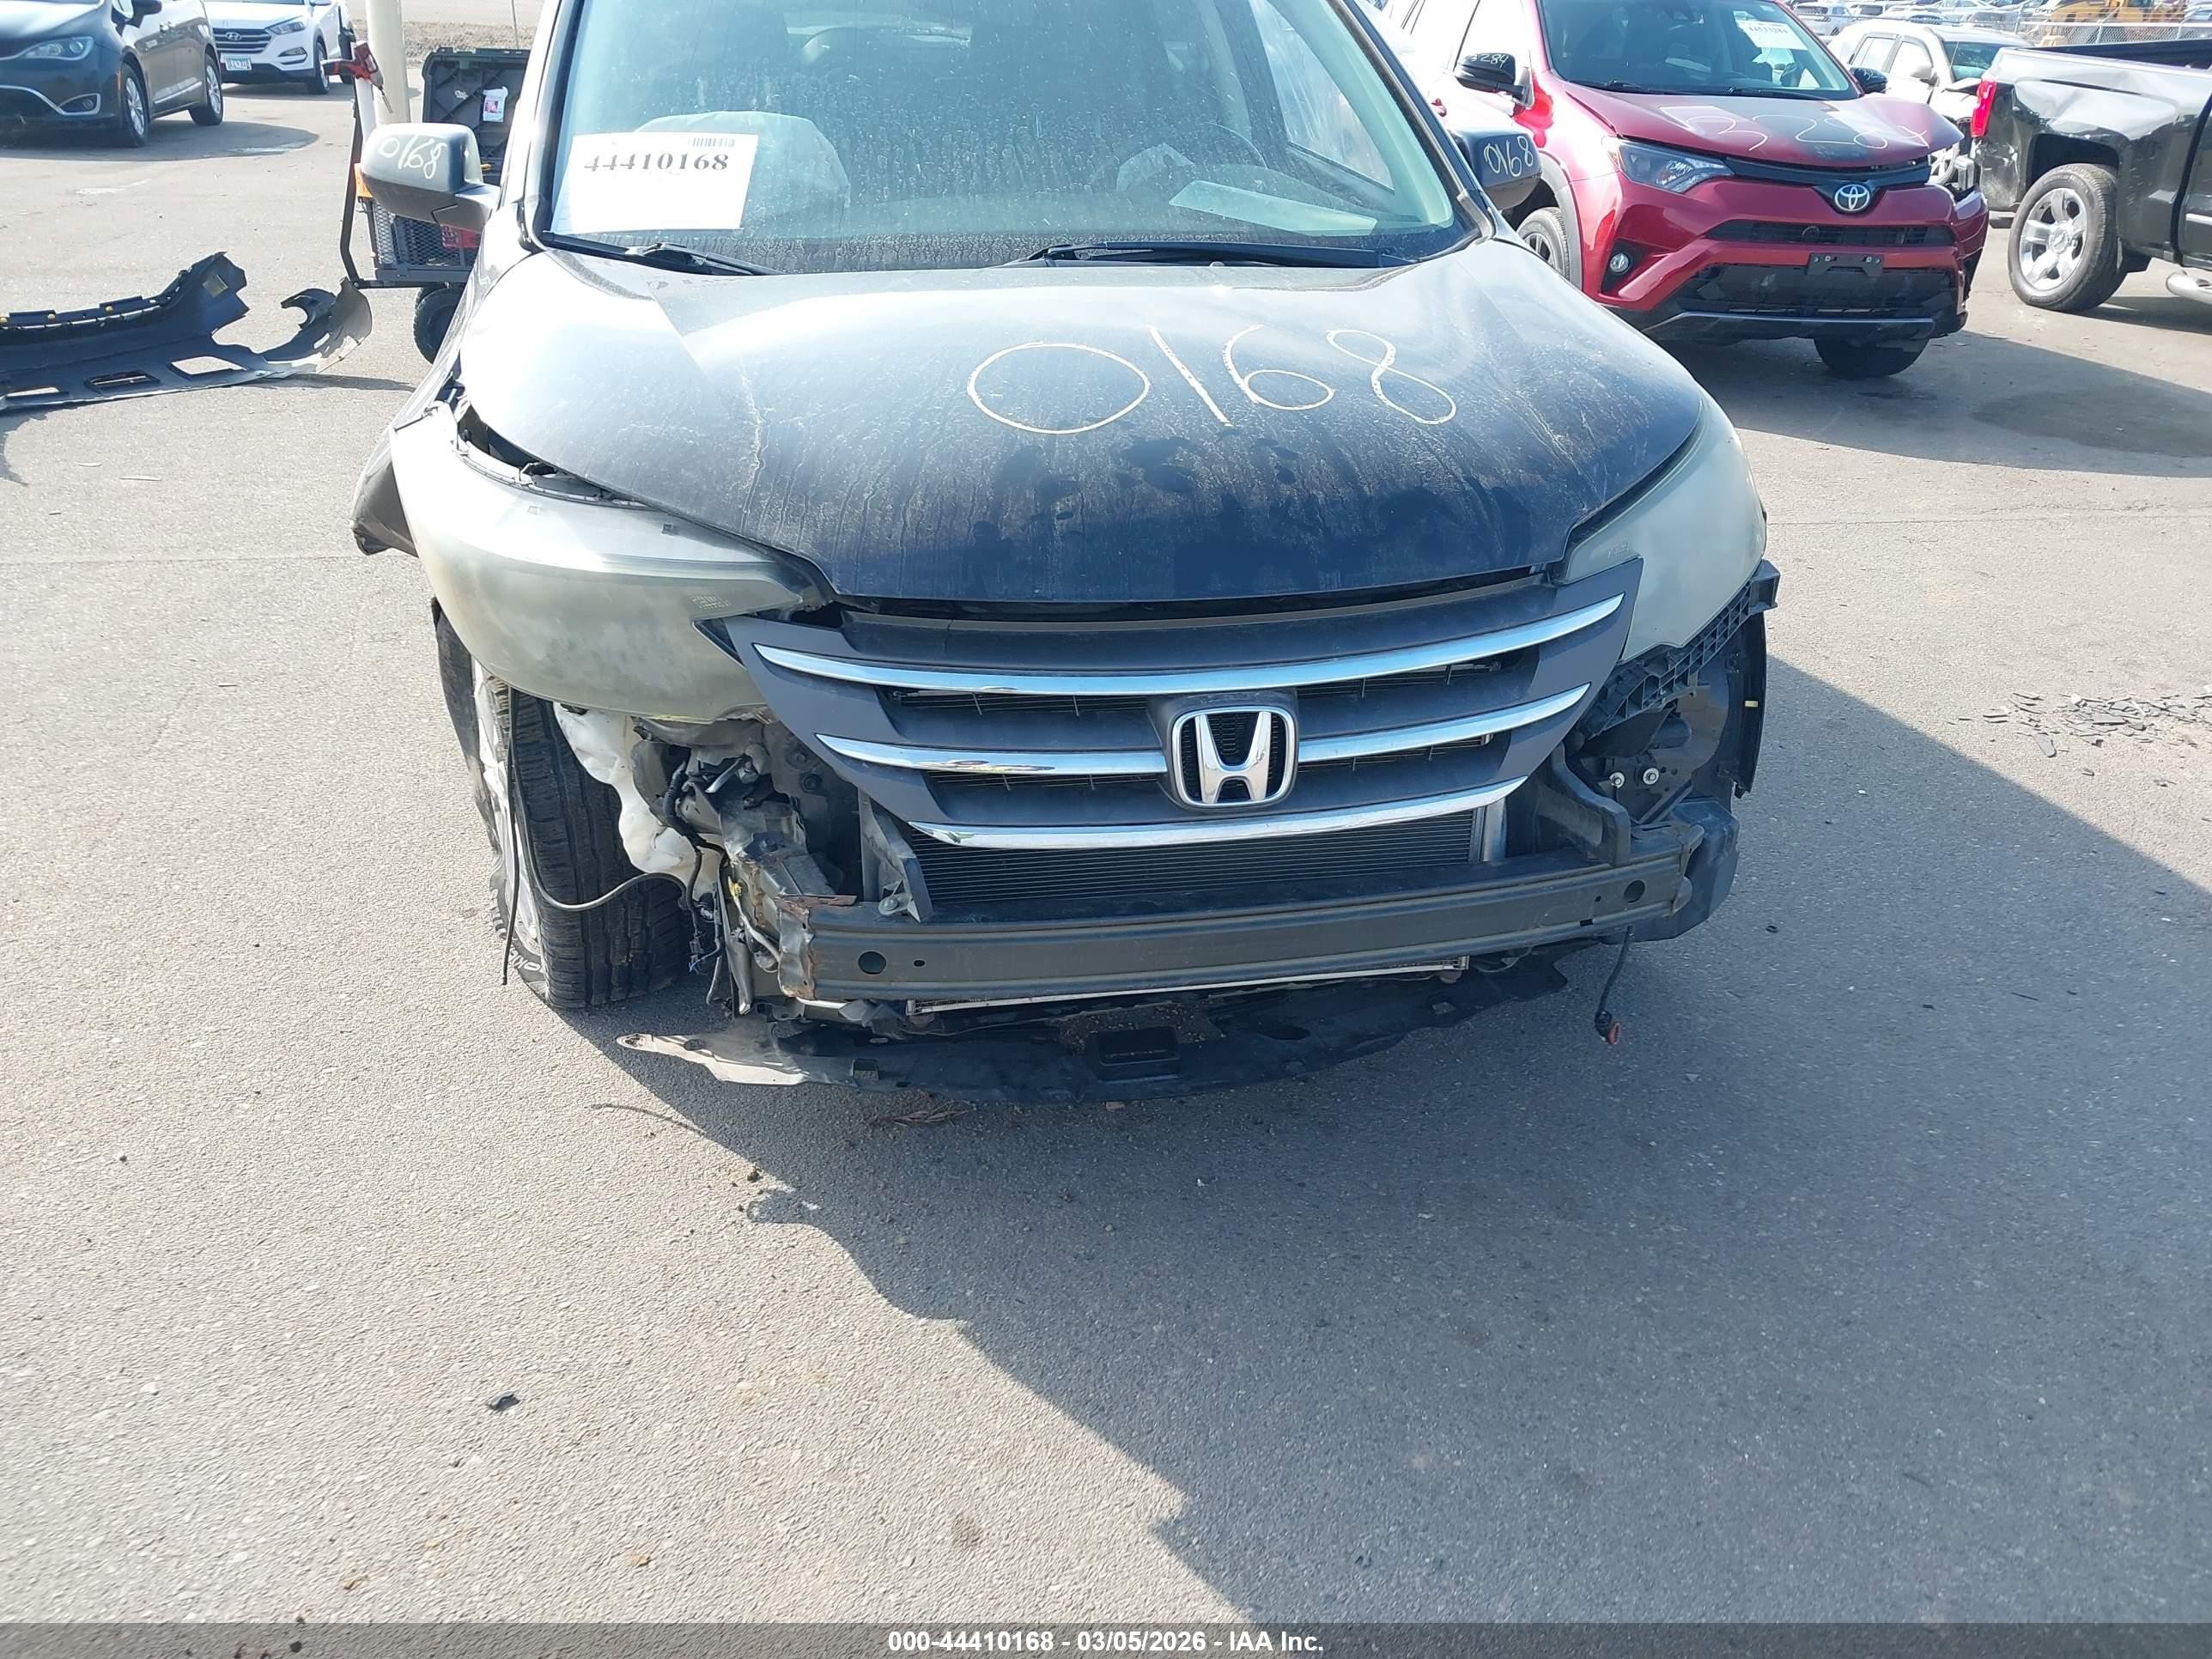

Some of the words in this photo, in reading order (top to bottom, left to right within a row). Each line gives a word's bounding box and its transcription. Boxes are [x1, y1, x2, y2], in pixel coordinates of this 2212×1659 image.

[377, 134, 447, 179] 0168
[583, 152, 729, 172] 44410168
[1483, 135, 1534, 178] 0168
[966, 325, 1457, 435] 0168
